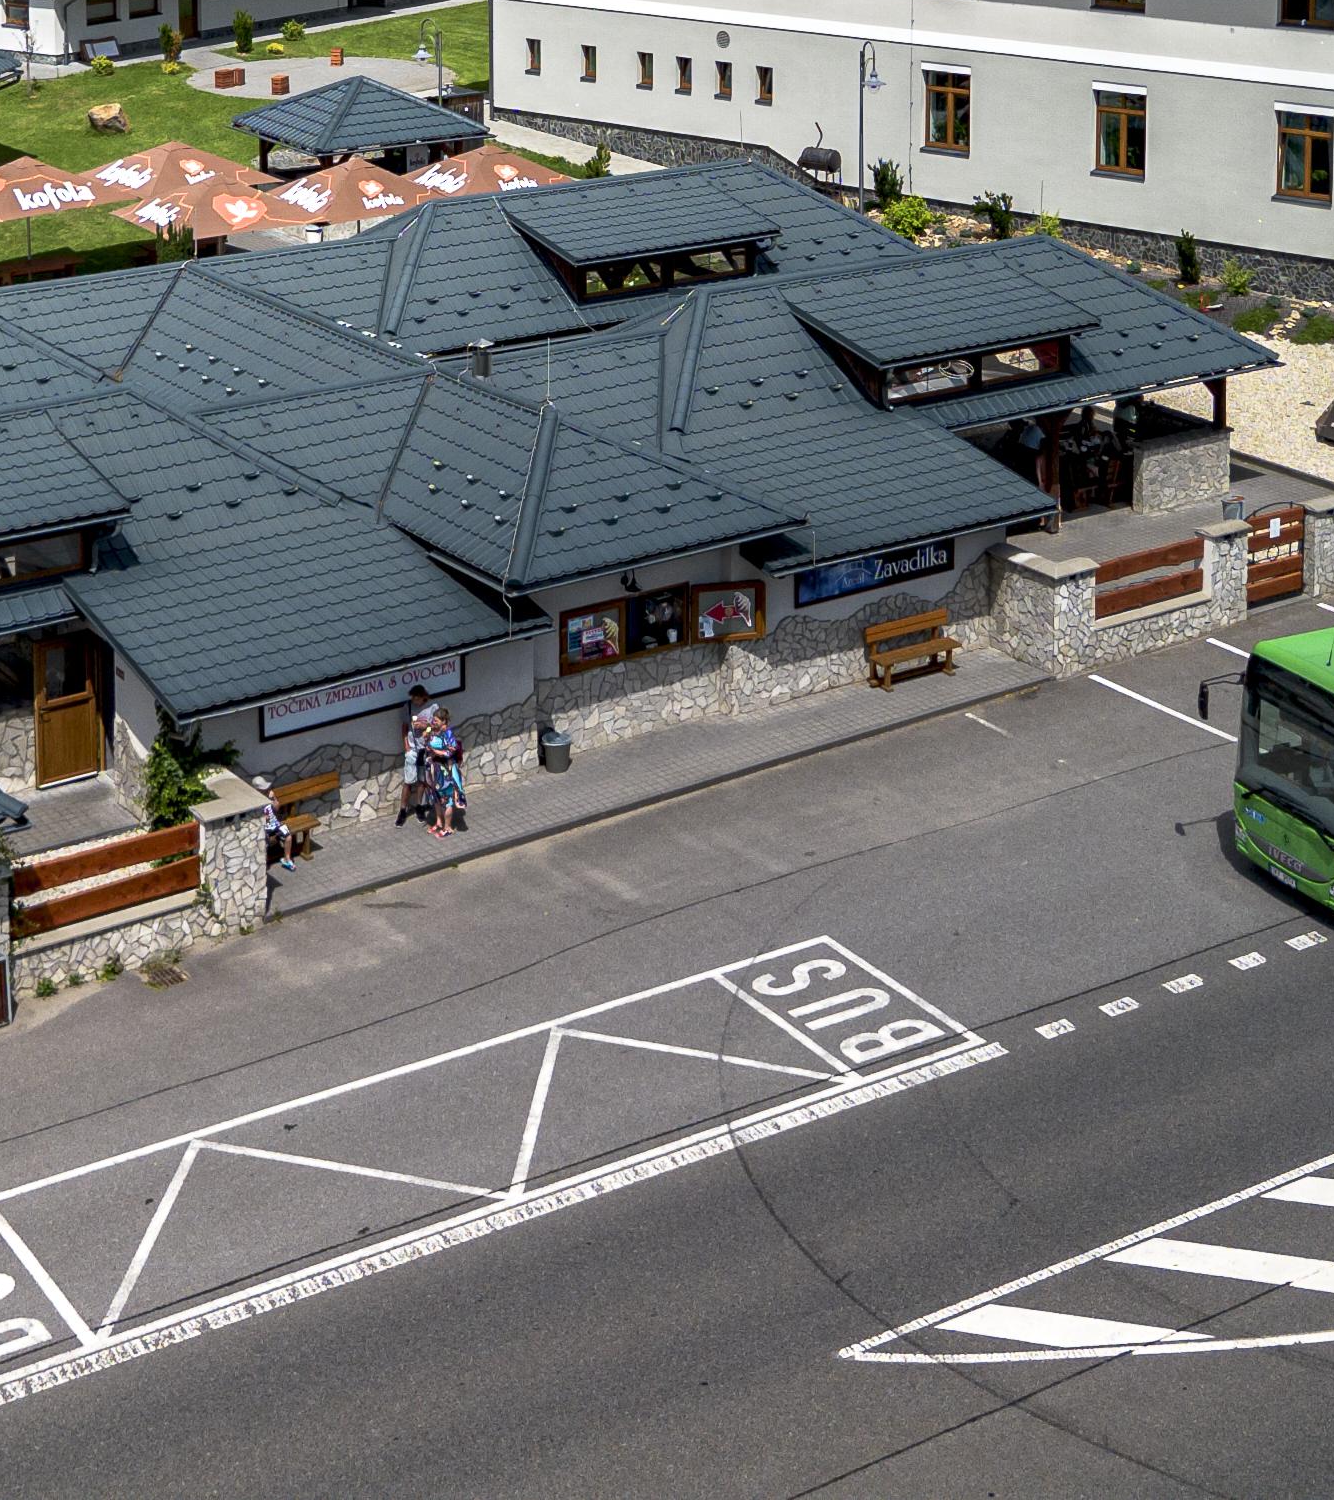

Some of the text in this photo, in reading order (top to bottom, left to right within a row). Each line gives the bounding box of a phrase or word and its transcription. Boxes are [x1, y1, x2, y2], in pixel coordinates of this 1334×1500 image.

[13, 181, 96, 211] kofola
[361, 193, 405, 210] kofola
[874, 545, 948, 580] Zavadilka
[326, 678, 384, 705] ZMRZLINA
[402, 659, 457, 685] OVOCEM
[1266, 845, 1303, 874] IVECO
[751, 958, 946, 1064] BUS
